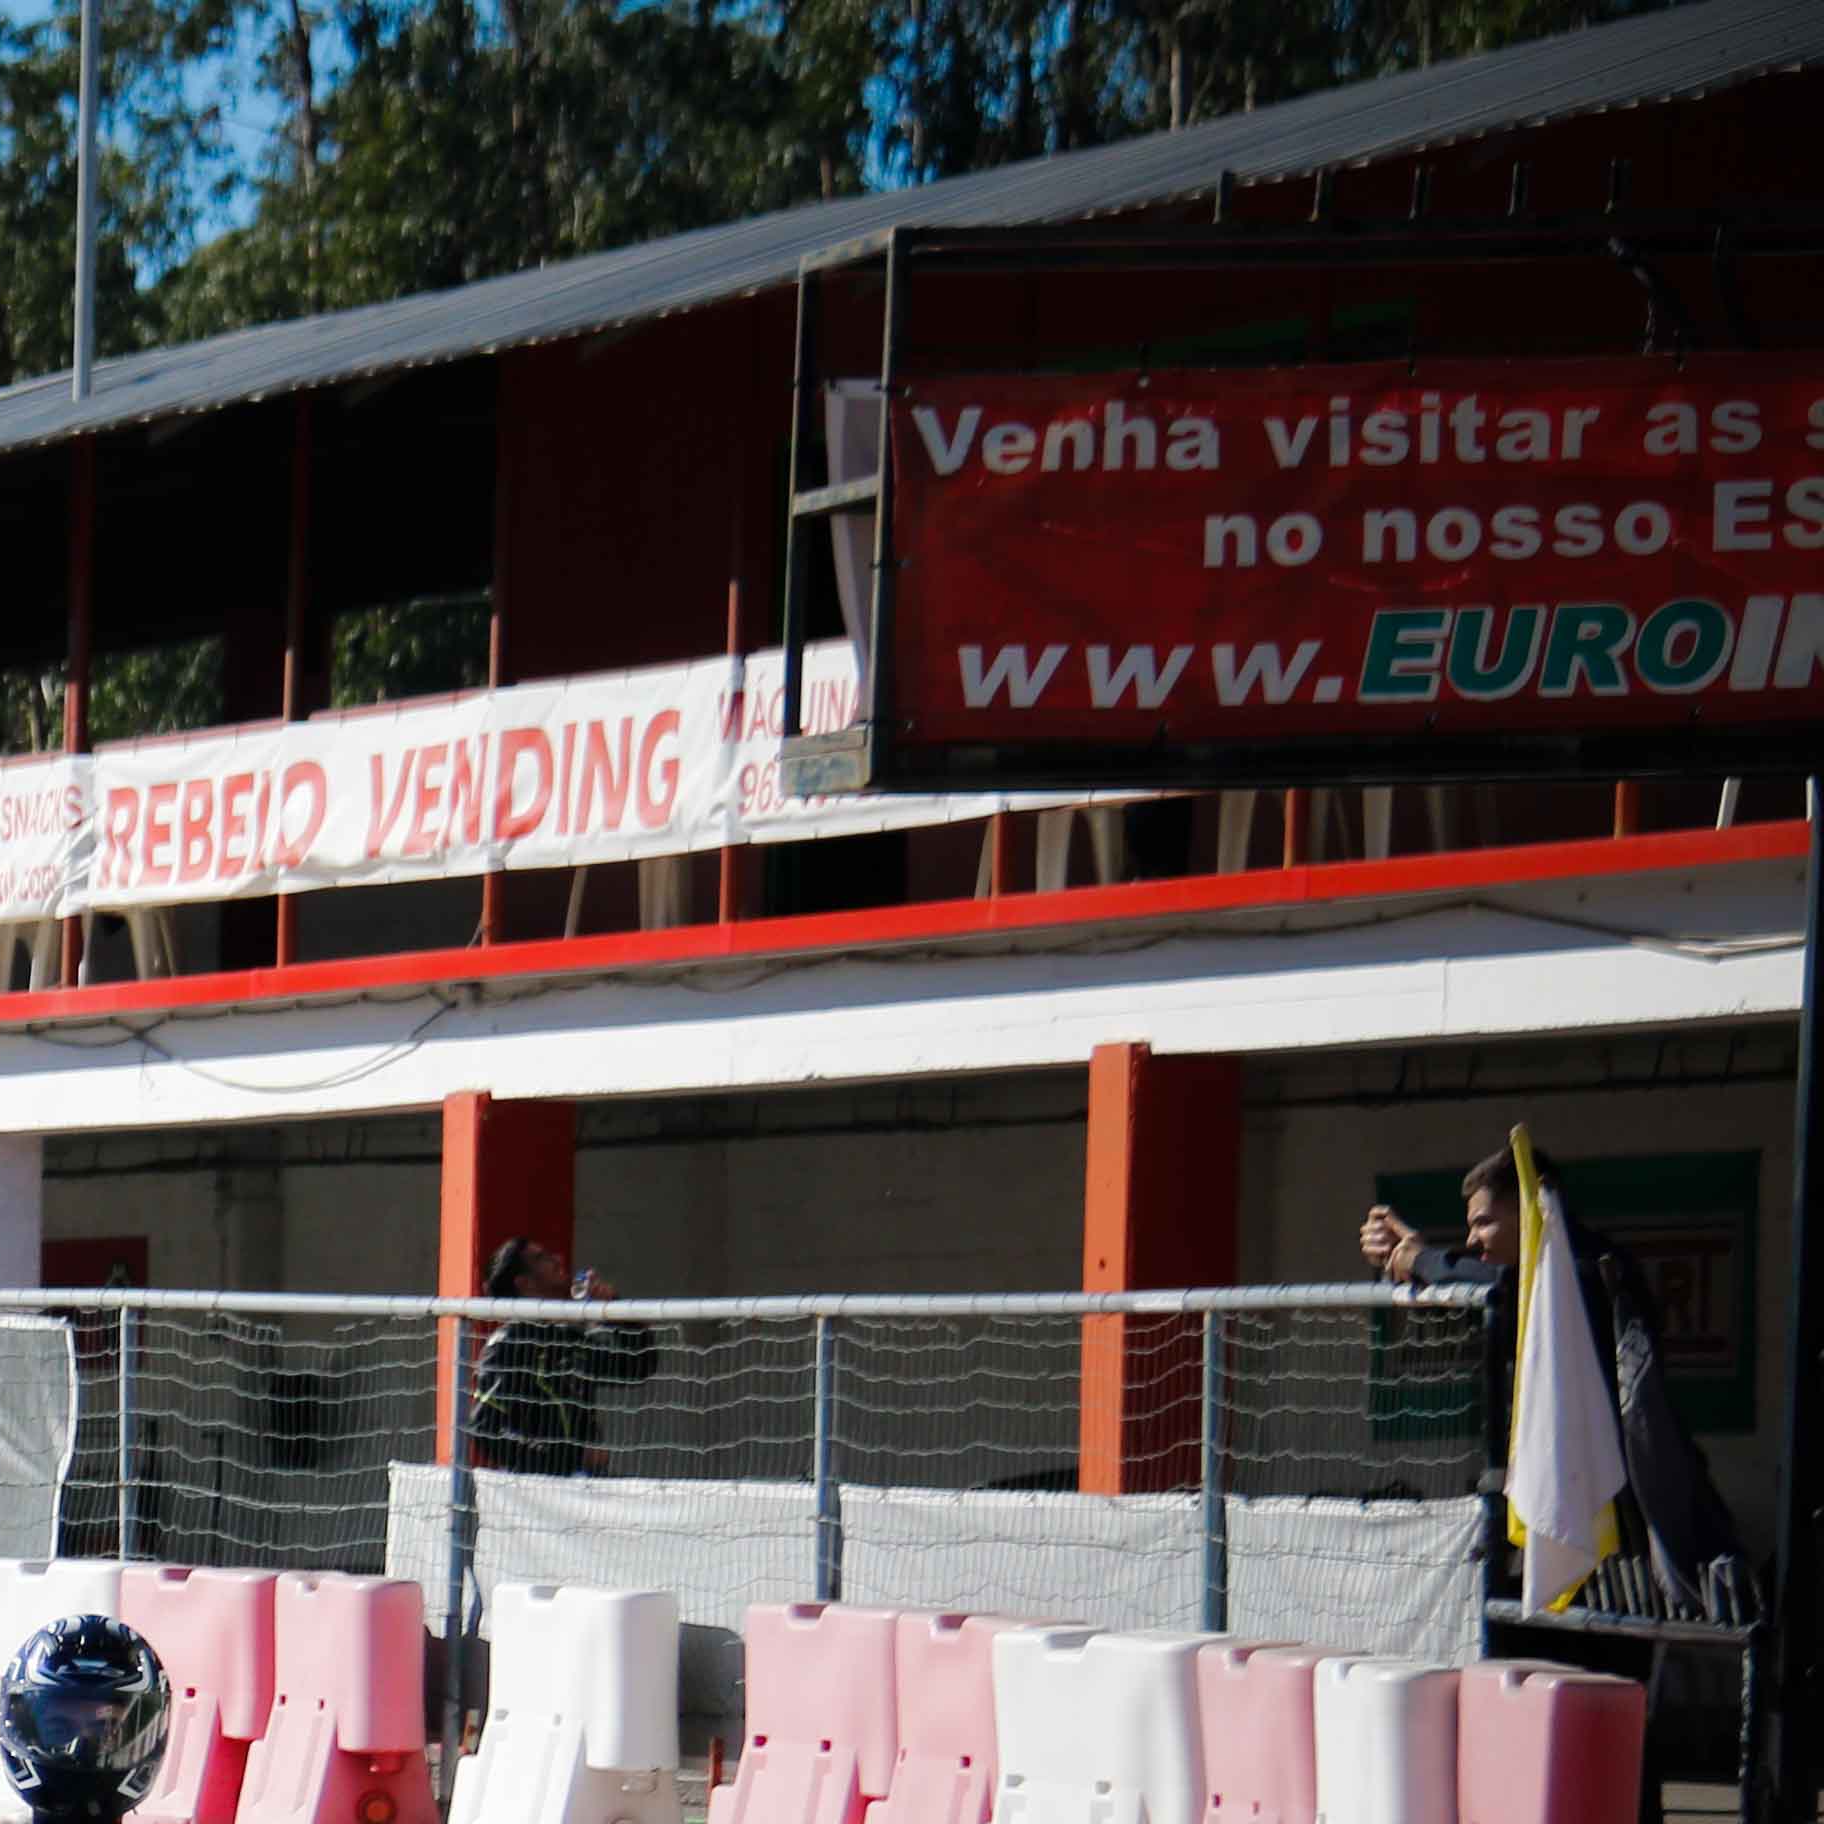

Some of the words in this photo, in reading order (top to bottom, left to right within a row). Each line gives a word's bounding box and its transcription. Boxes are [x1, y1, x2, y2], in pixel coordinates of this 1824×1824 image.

[911, 400, 1219, 476] Venha
[1264, 393, 1601, 471] visitar
[1642, 401, 1761, 457] as
[1203, 509, 1322, 570] no
[1362, 499, 1672, 564] nosso
[365, 709, 681, 860] VENDING
